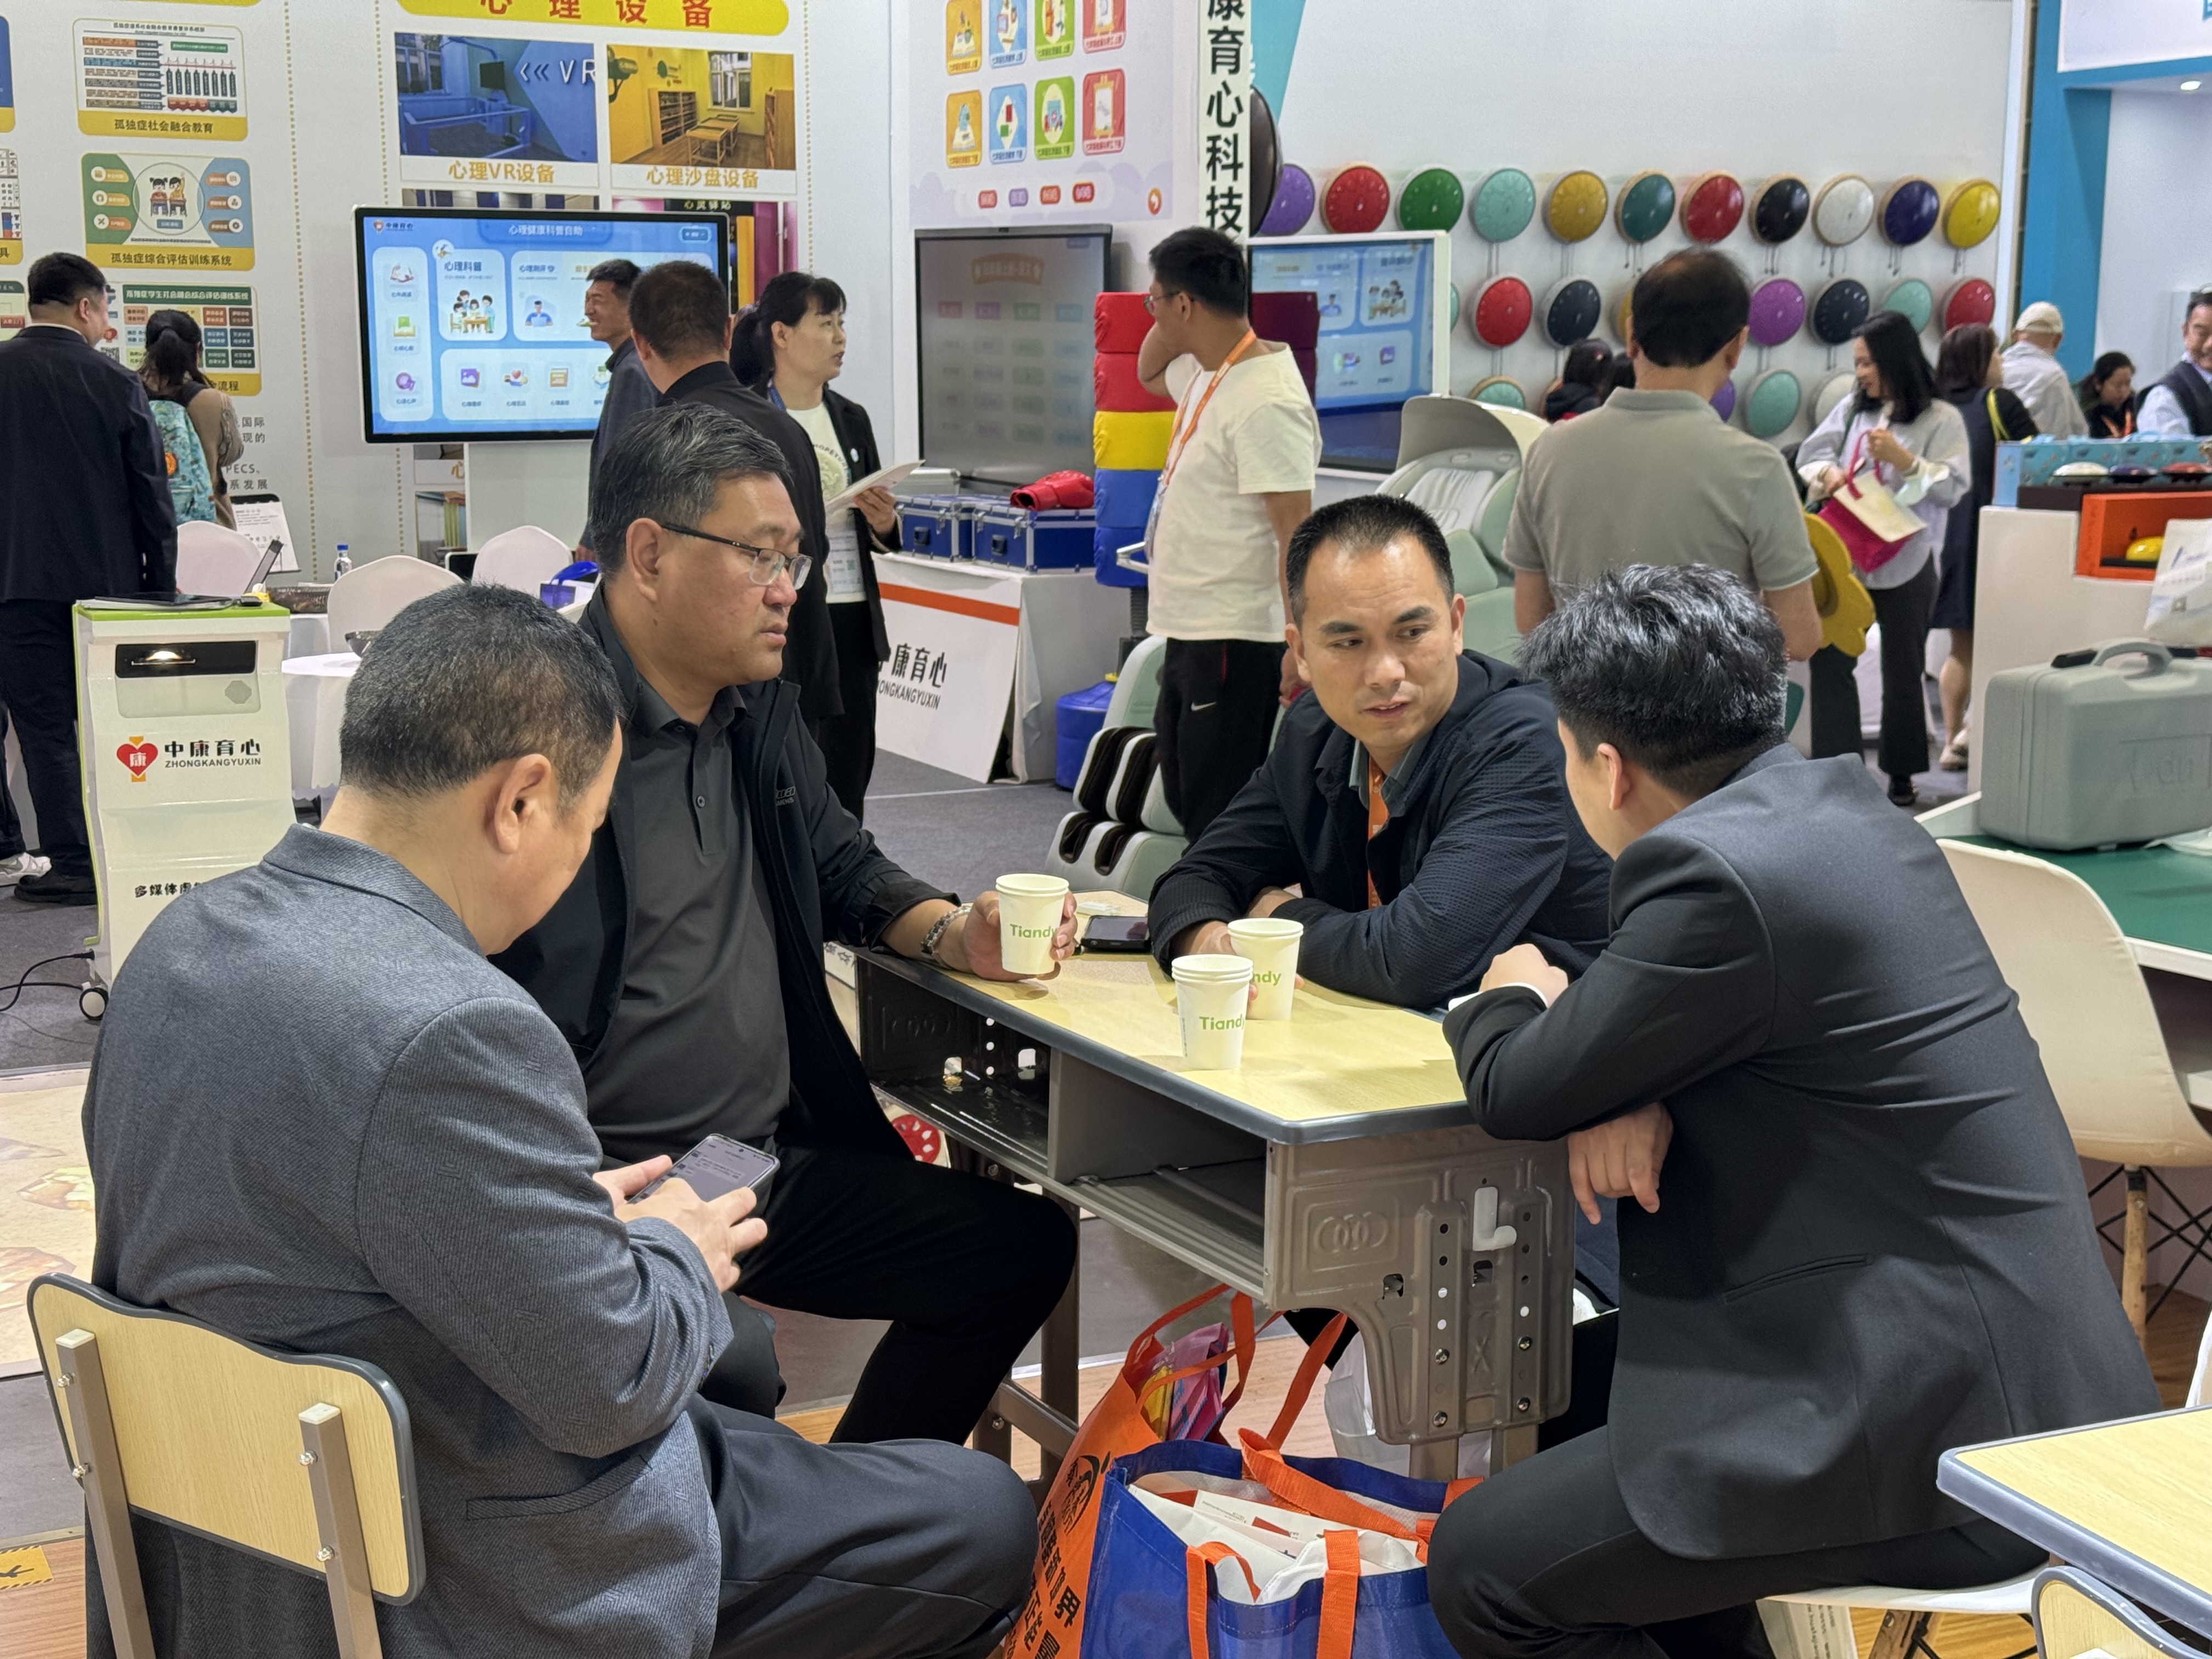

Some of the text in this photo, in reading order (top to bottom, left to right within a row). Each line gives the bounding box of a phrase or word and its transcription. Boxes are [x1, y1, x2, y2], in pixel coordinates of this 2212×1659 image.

[114, 119, 214, 134] 孤独症社会融合教育
[448, 161, 555, 184] 心理VR设备
[646, 167, 759, 189] 心理沙盘设备
[111, 252, 233, 267] 孤独症综合评估训练系统
[238, 416, 265, 428] 国际
[165, 739, 260, 757] 中康育心
[165, 758, 261, 768] ZHONGKANGYUXIN
